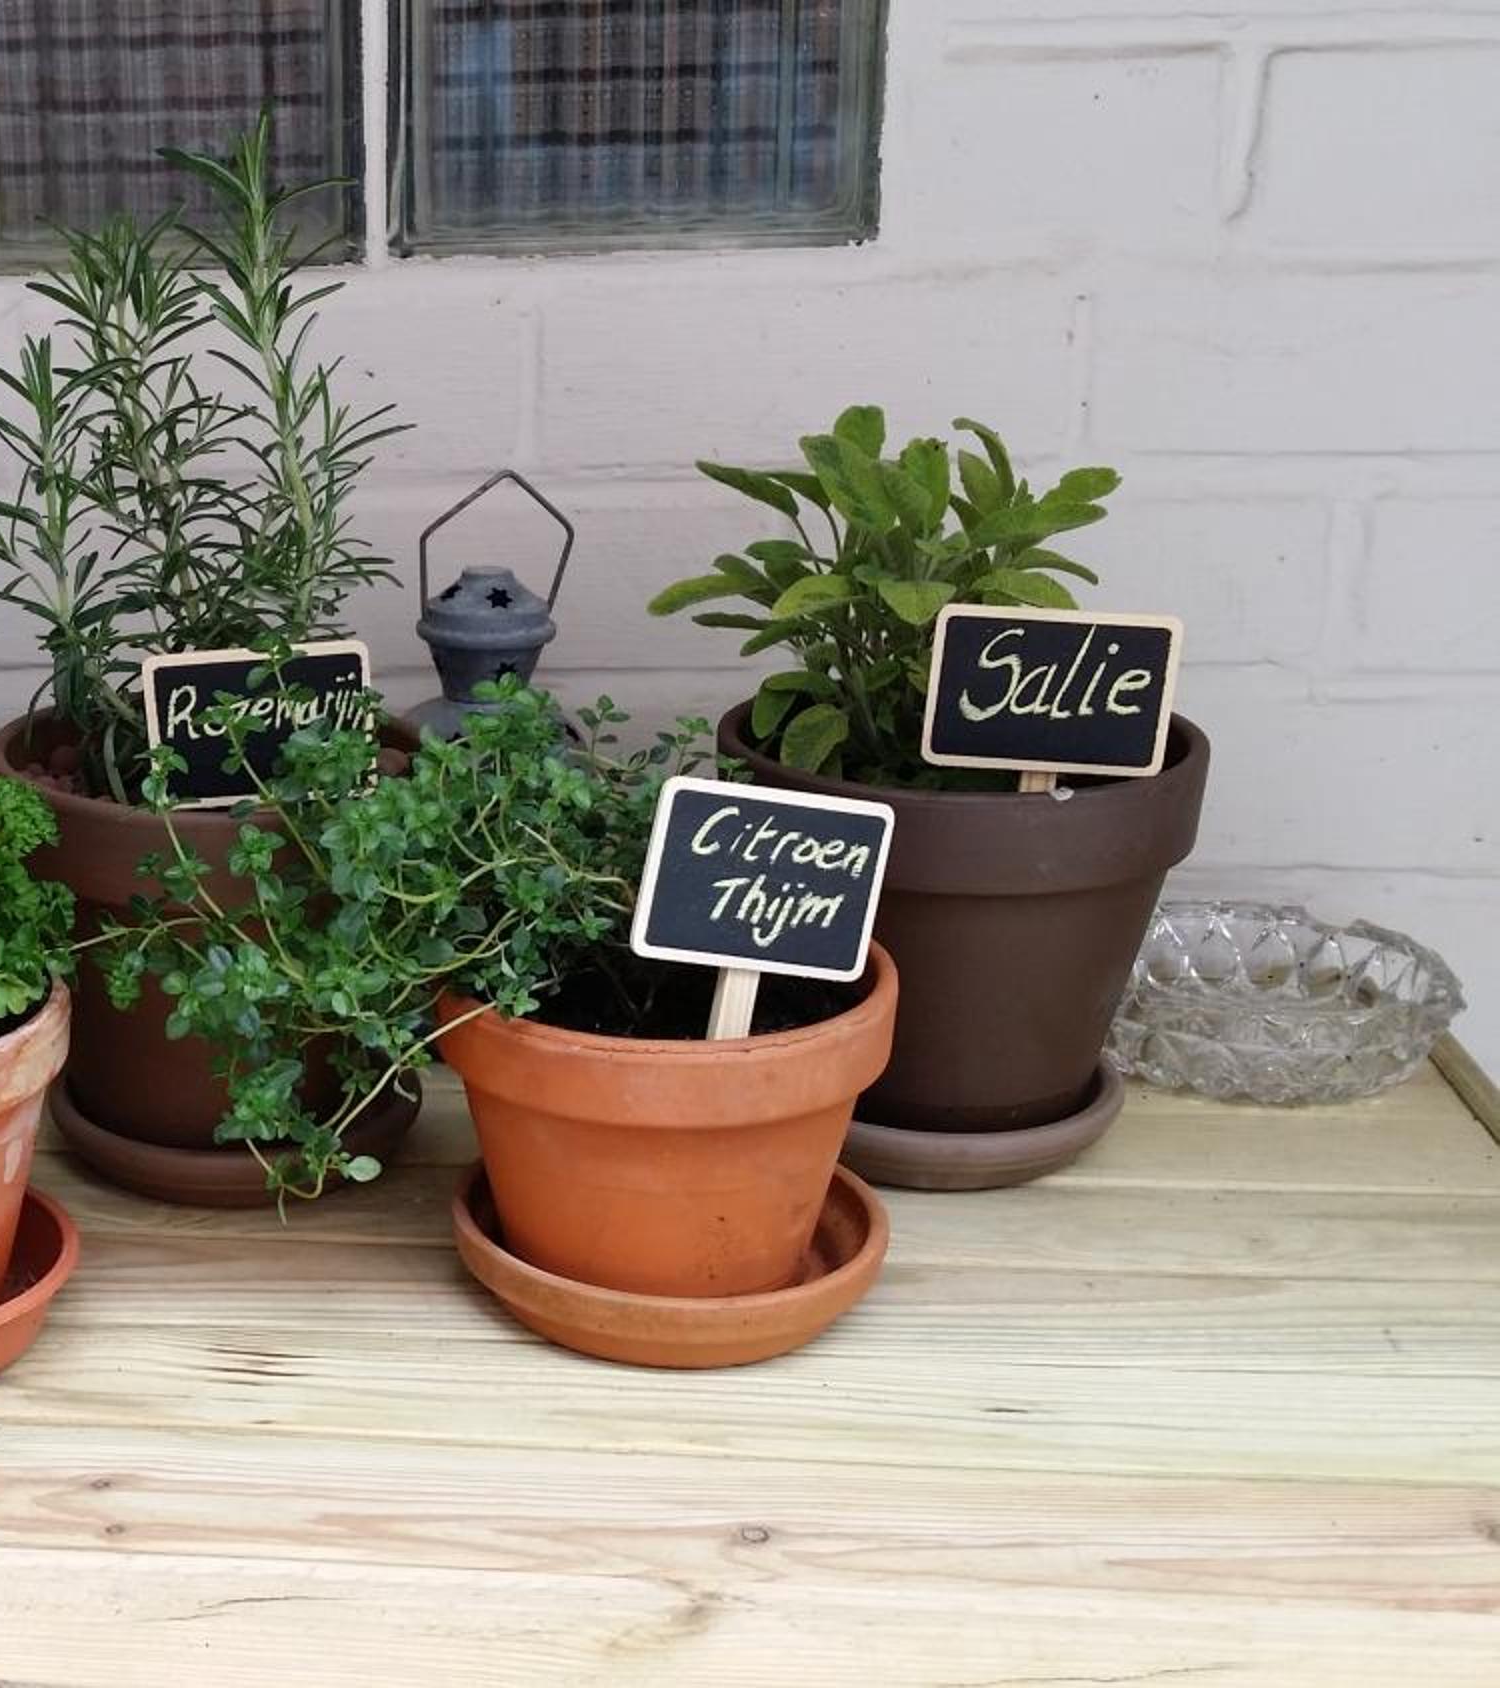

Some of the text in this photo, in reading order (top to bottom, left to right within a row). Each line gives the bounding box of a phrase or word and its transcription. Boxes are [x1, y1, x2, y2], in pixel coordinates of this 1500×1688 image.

[958, 623, 1152, 722] Salie
[690, 805, 871, 879] Citroen
[709, 873, 846, 948] Thijm
